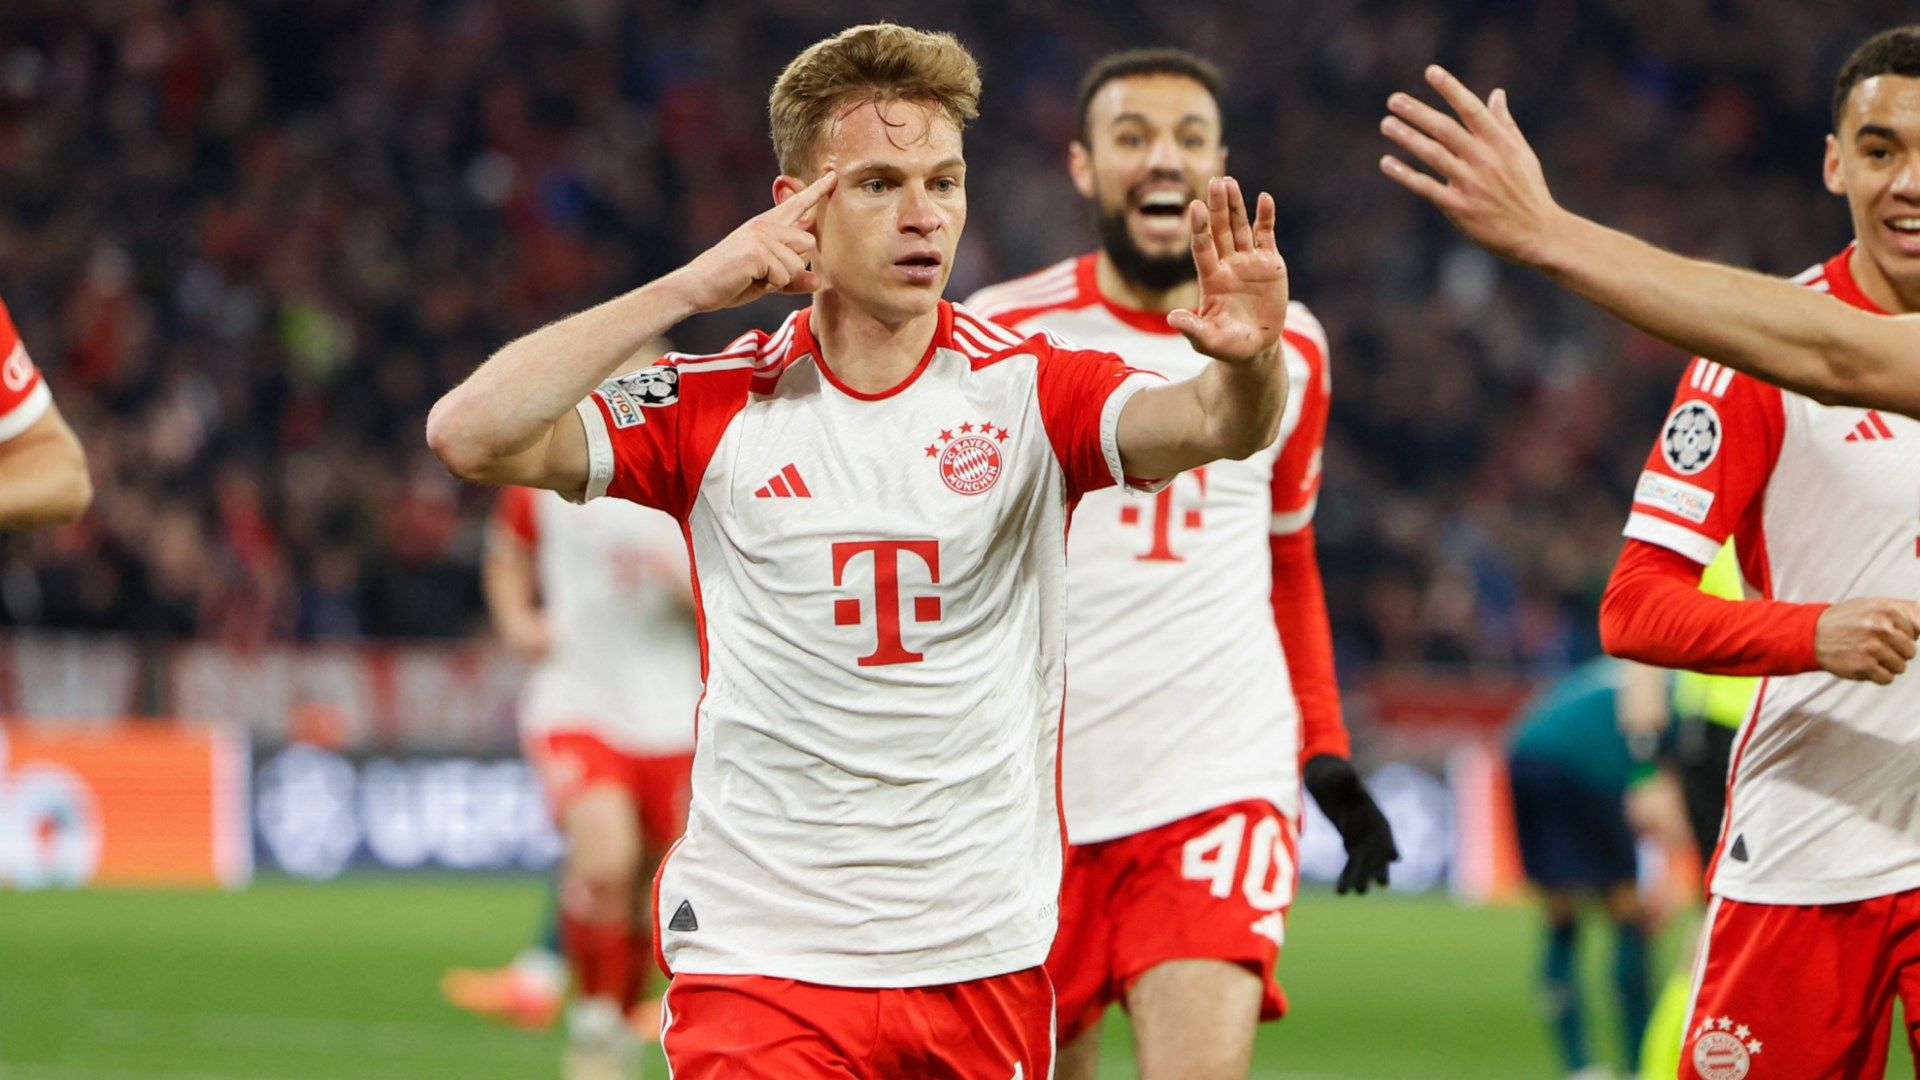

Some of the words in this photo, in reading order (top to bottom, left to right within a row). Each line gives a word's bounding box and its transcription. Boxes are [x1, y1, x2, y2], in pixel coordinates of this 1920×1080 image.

[944, 450, 956, 465] FC
[954, 439, 995, 456] BAYERN
[946, 465, 998, 491] MÜNCHEN
[832, 540, 941, 666] T
[1181, 813, 1294, 911] 40
